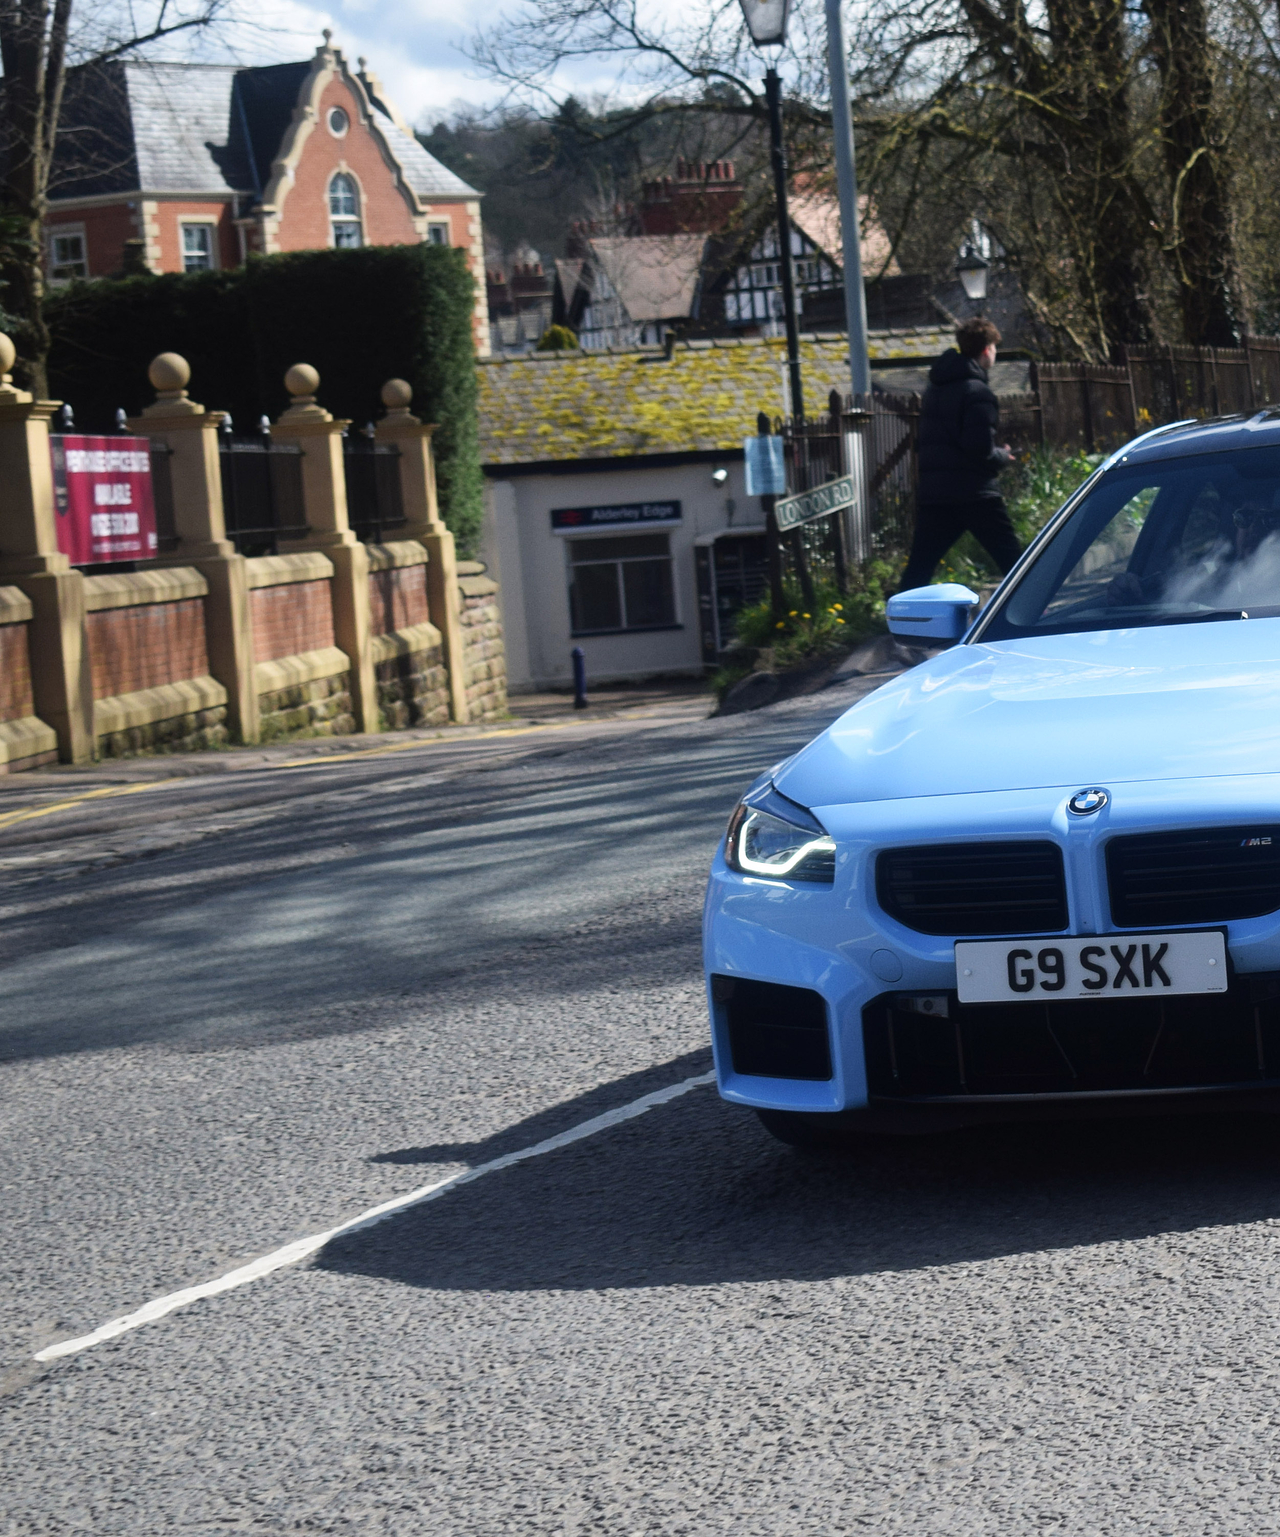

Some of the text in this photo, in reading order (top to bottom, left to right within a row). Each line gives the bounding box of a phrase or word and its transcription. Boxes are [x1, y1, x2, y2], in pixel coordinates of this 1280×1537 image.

[591, 504, 674, 521] Alderley Edge
[778, 481, 853, 526] LONDON RD
[1006, 942, 1172, 993] G9 SXK
